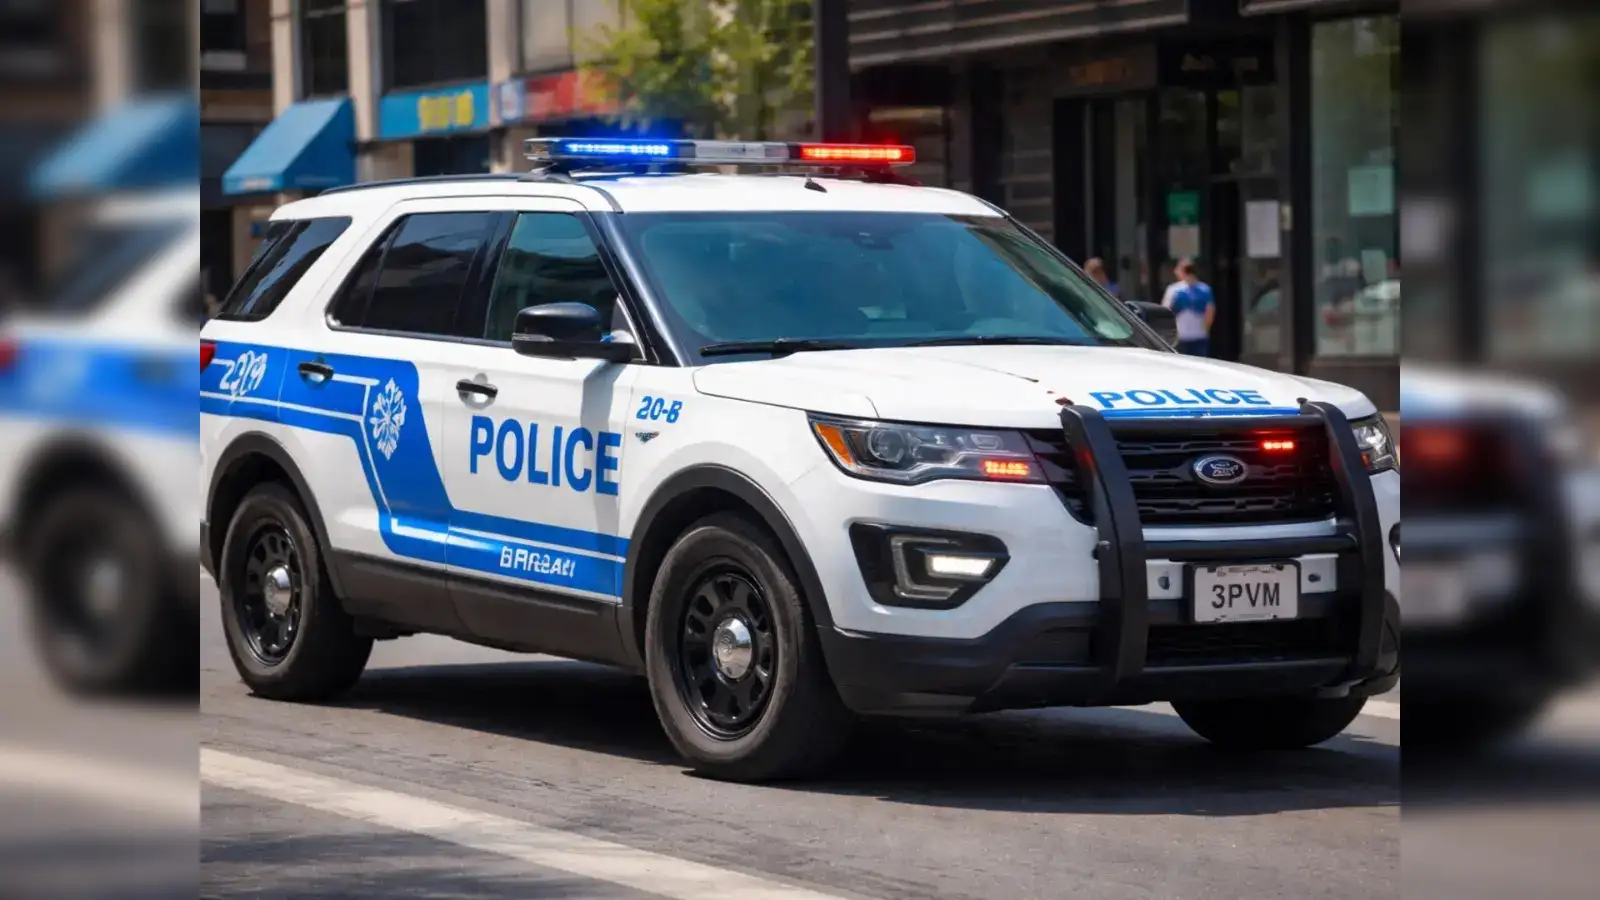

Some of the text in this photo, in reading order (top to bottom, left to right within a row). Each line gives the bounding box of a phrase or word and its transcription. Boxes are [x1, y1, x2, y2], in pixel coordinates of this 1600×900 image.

[1089, 388, 1271, 408] POLICE
[470, 415, 622, 496] POLICE
[1212, 582, 1280, 608] 3PVM
